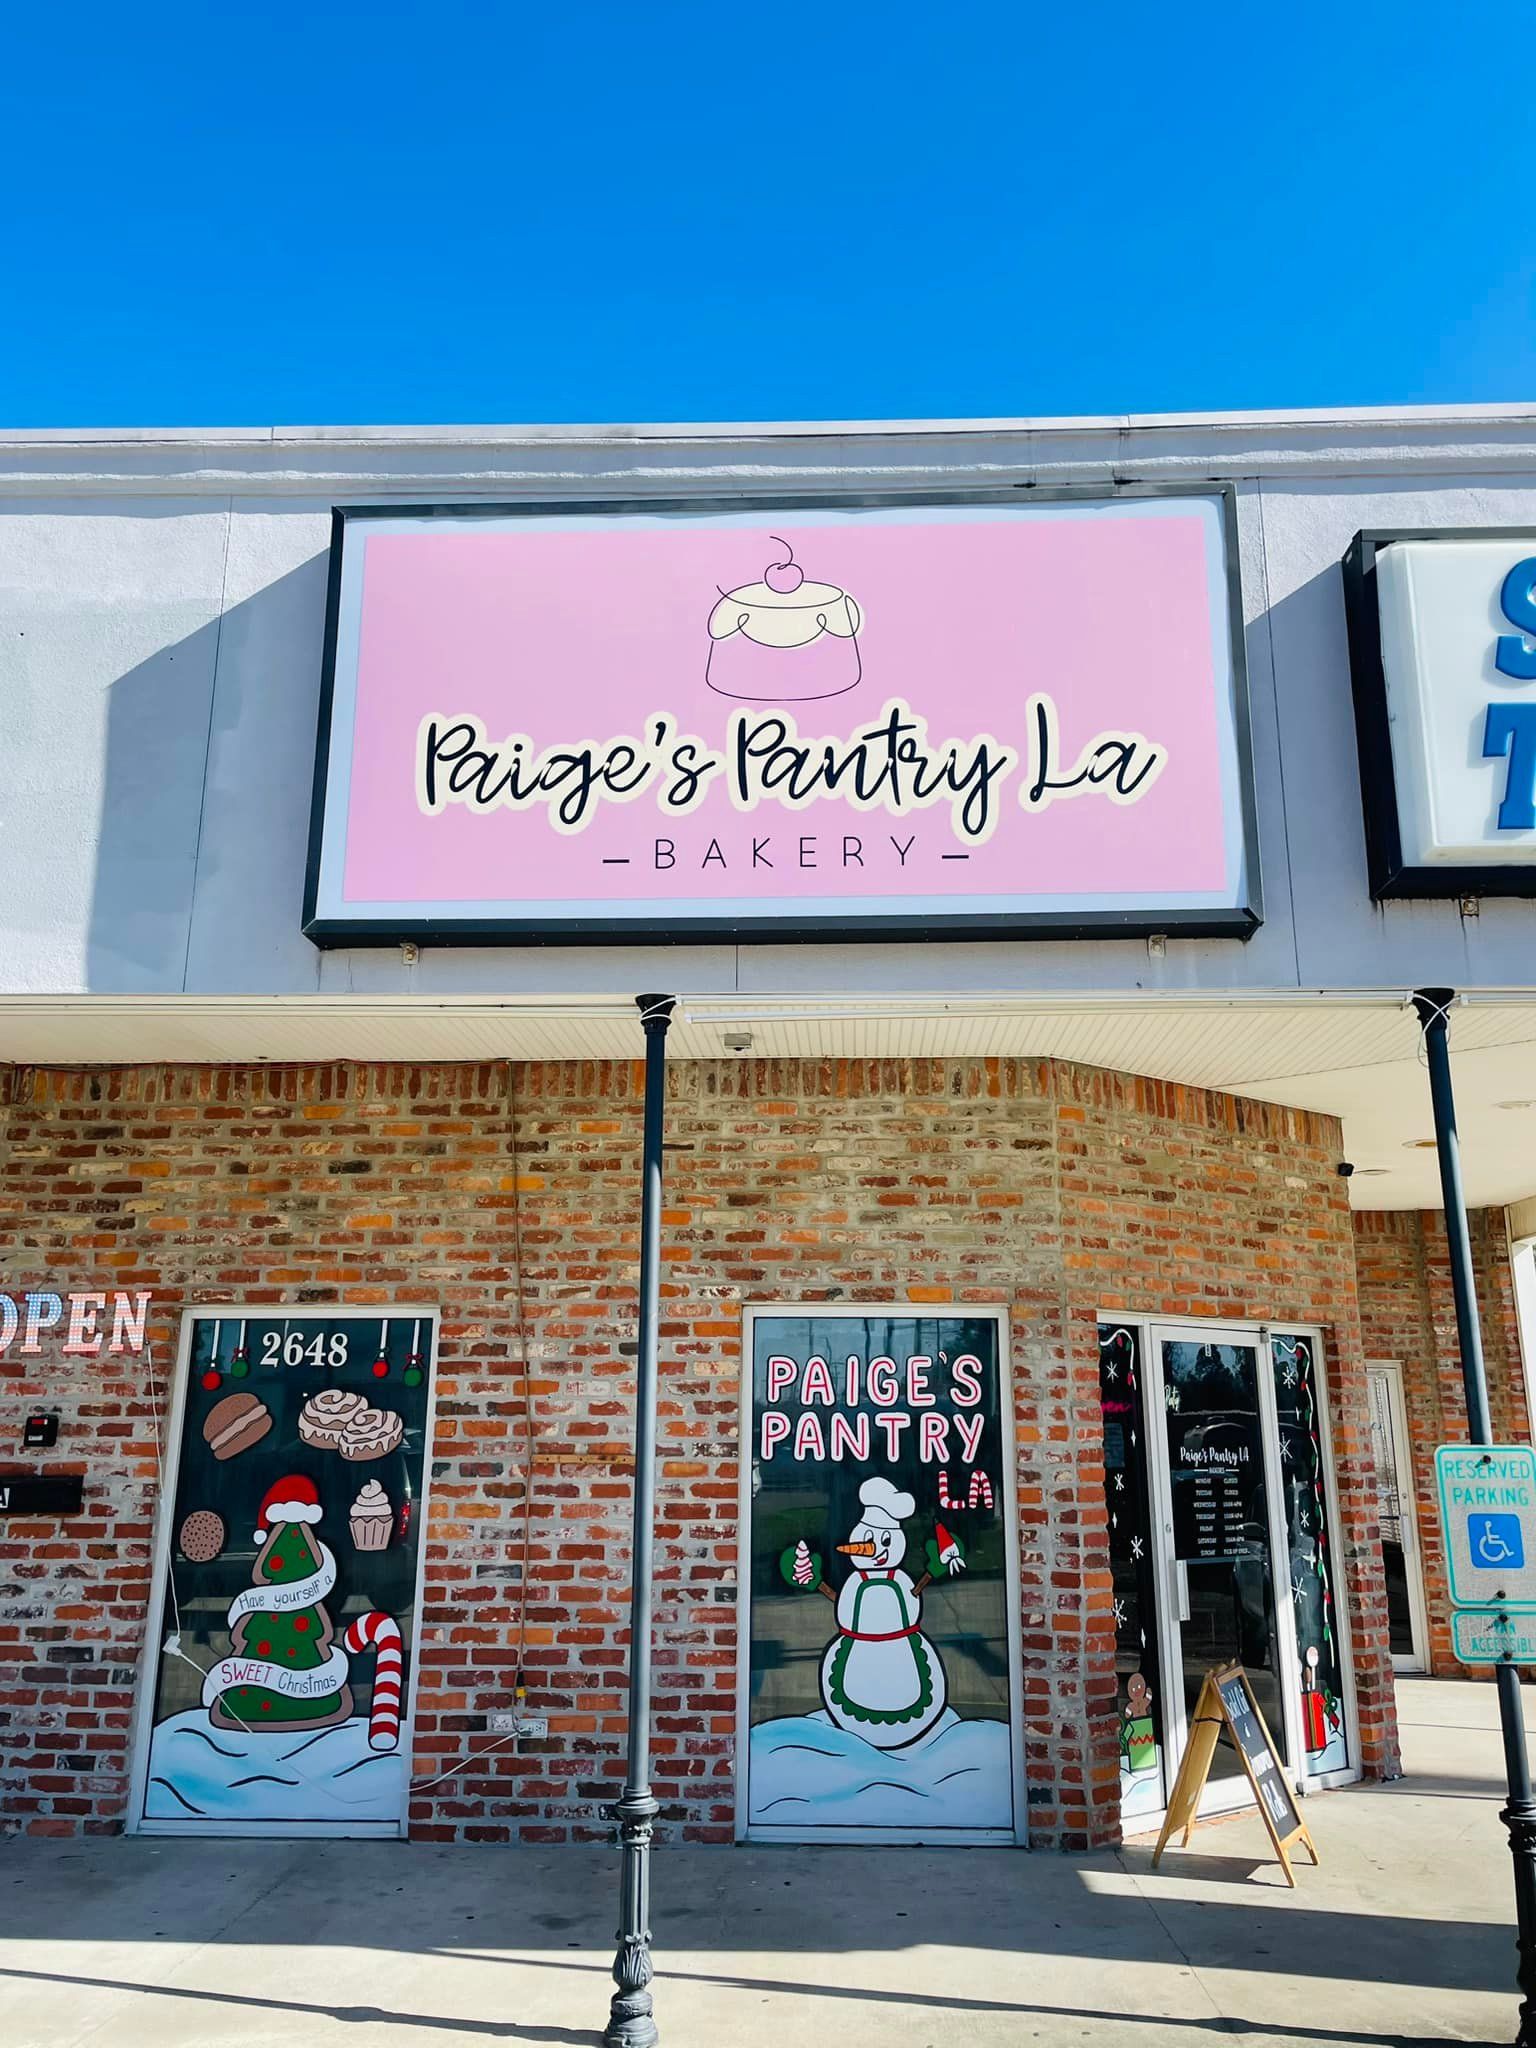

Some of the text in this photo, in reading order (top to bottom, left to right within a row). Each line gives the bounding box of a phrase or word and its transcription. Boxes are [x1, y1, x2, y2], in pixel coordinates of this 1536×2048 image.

[426, 702, 1157, 835] Paige's Pantry La
[655, 836, 915, 869] BAKERY
[260, 1332, 349, 1368] 2648
[767, 1352, 984, 1407] PAIGE'S
[760, 1411, 985, 1463] PANTRY
[1443, 1460, 1530, 1479] RESERVED
[938, 1470, 993, 1509] LA
[1452, 1487, 1530, 1506] PARKING
[239, 1575, 333, 1610] Have yourself a
[221, 1661, 337, 1693] SWEET Christmas
